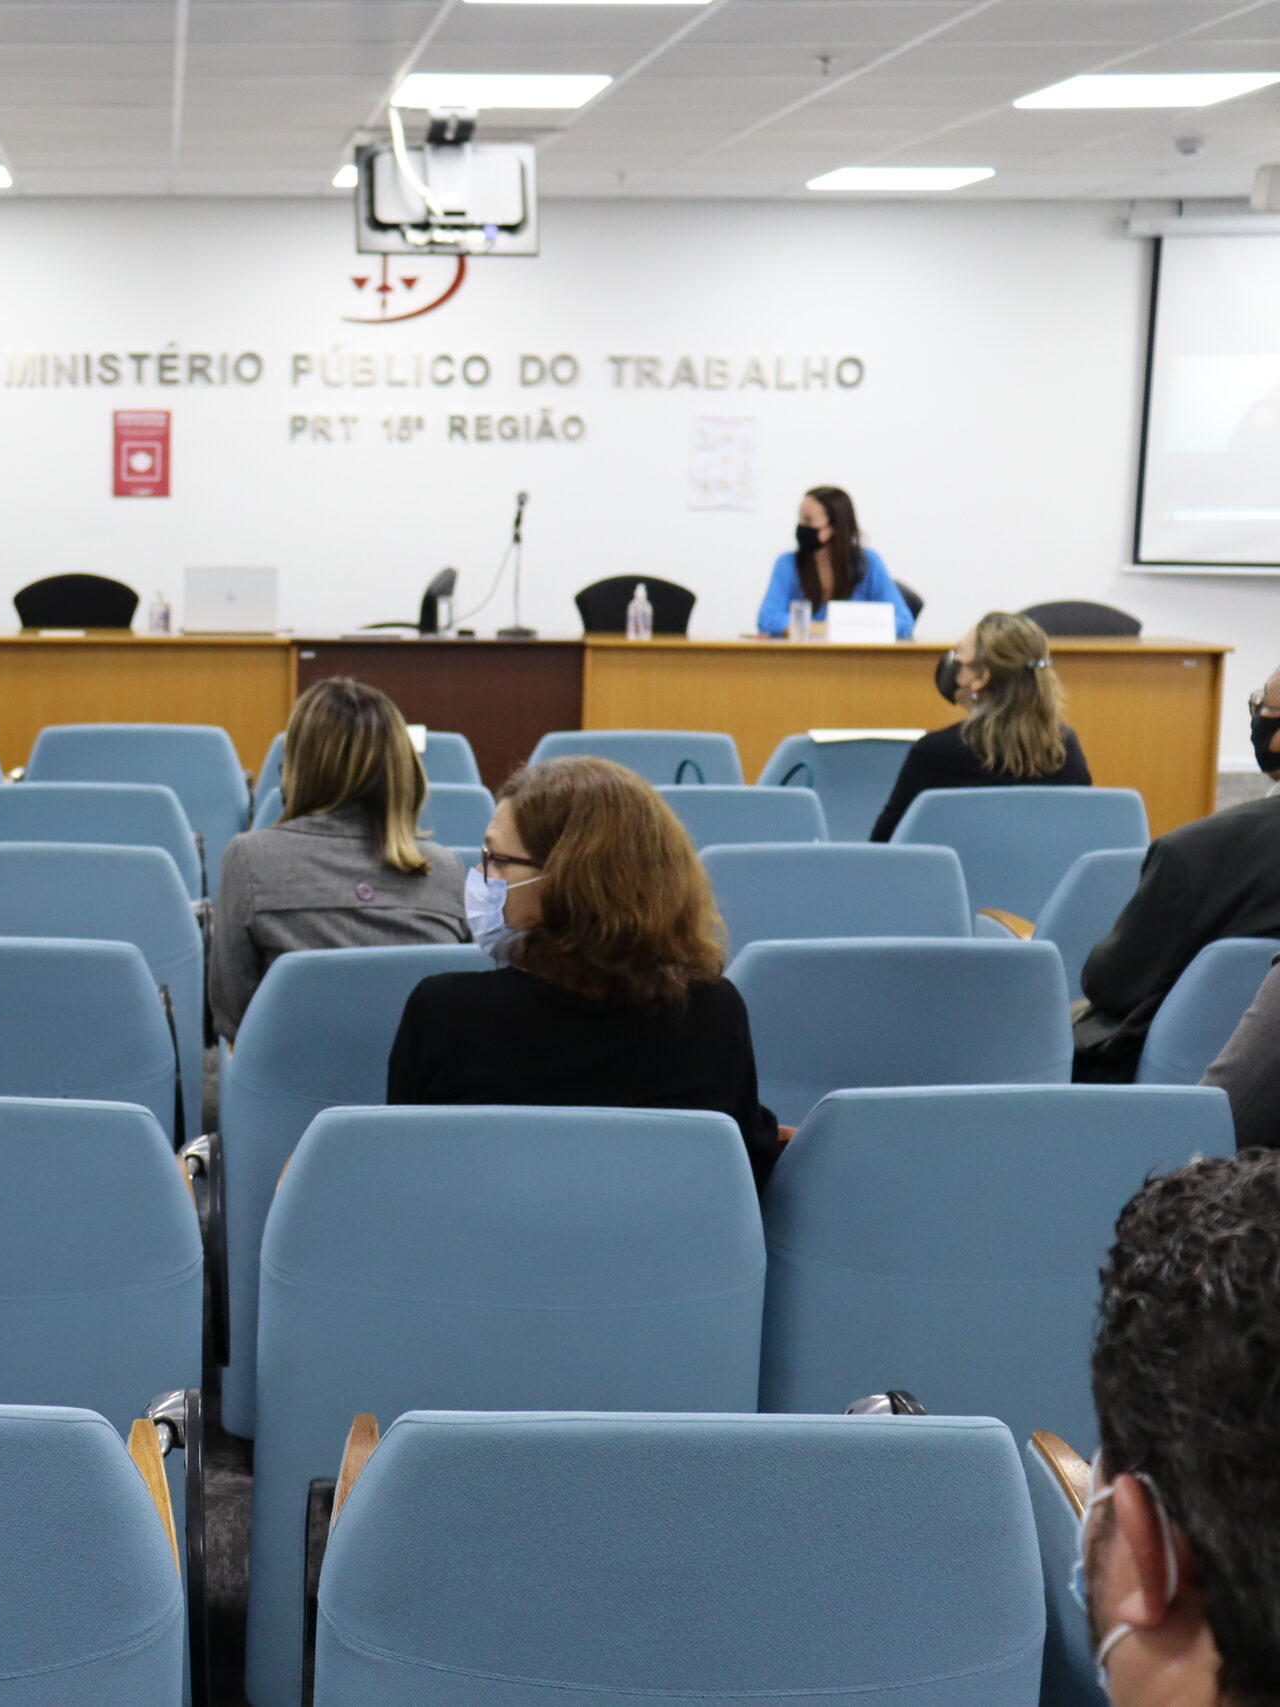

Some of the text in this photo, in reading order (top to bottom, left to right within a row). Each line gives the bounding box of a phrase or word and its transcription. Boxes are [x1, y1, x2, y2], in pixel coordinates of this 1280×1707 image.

[4, 341, 865, 390] MINISTÉRIO PÚBLICO DO TRABALHO
[289, 414, 358, 442] PRT
[447, 407, 585, 442] REGIÃO
